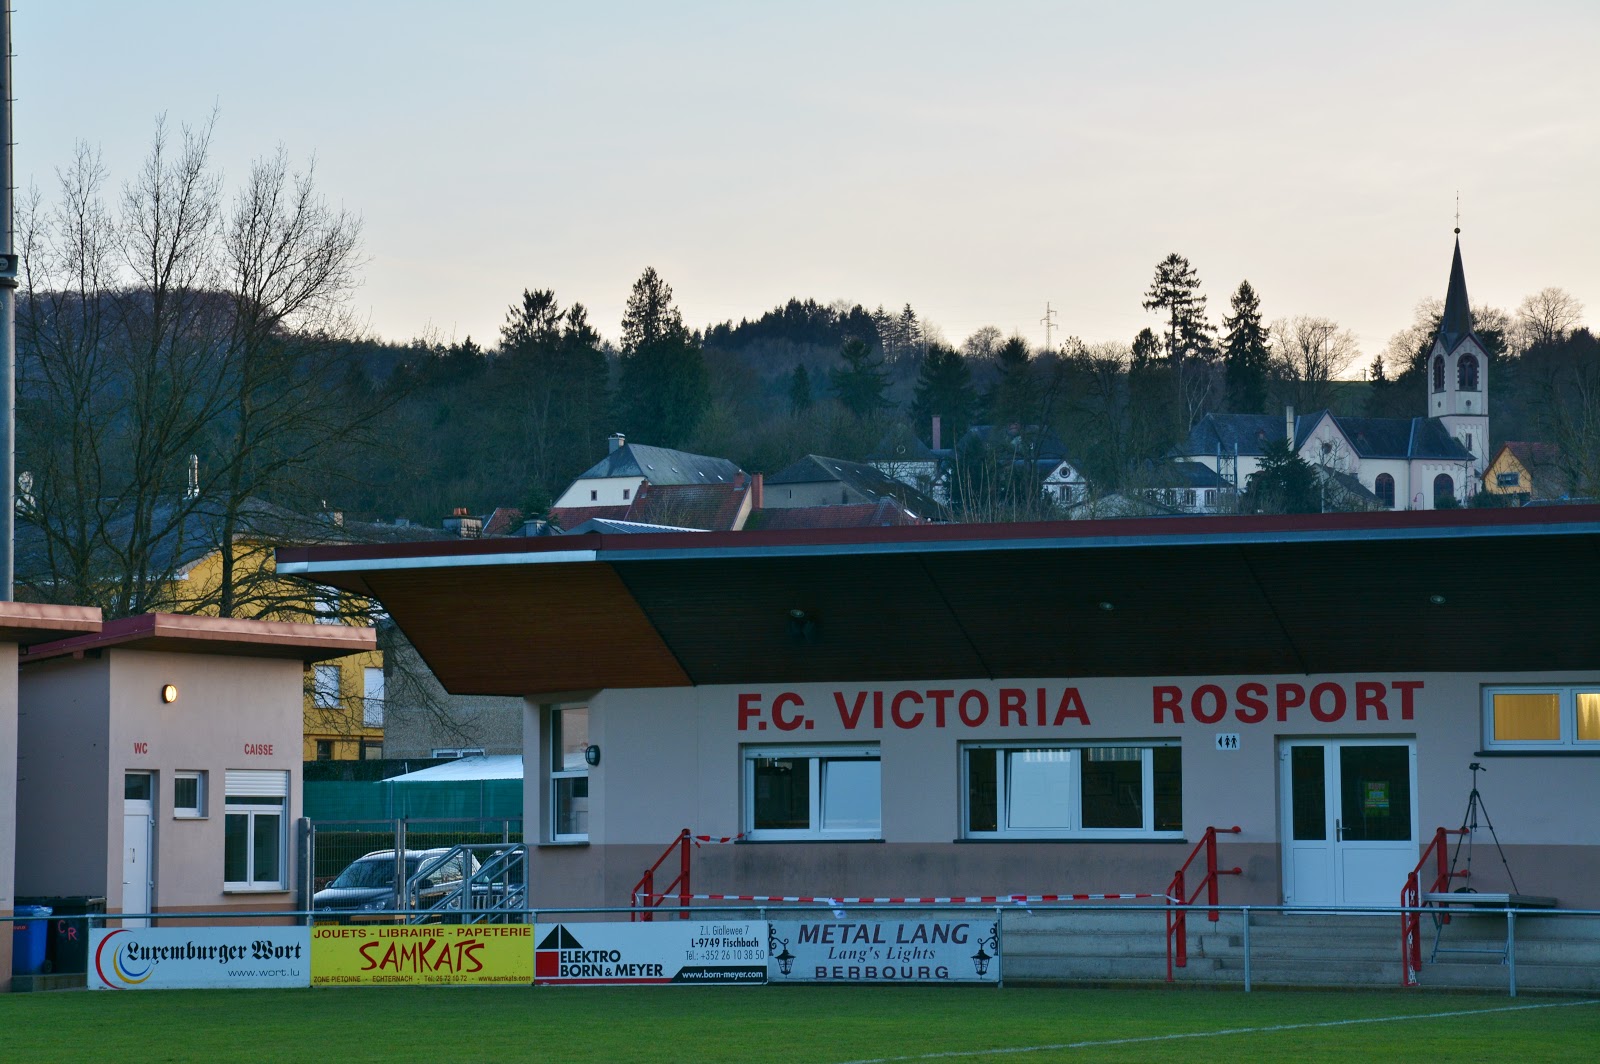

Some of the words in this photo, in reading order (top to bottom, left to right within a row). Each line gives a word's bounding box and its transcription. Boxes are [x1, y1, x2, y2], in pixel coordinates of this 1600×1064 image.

[738, 693, 814, 731] F.C.
[834, 687, 1091, 730] VICTORIA
[1153, 681, 1424, 723] ROSPORT
[134, 742, 148, 754] WC
[244, 744, 273, 755] CAISSE
[314, 929, 366, 938] JOUETS
[379, 928, 444, 938] LIBRAIRIE
[457, 928, 531, 936] PAPETERIE
[744, 925, 749, 934] 7
[798, 924, 886, 944] METAL
[896, 924, 969, 944] LANG
[691, 939, 720, 948] L-9749
[723, 938, 759, 947] Fischbach
[127, 941, 247, 965] Luxemburger
[252, 940, 301, 960] Wort
[359, 938, 485, 973] SAMKATS
[561, 950, 621, 963] ELEKTRO
[701, 950, 718, 960] +352
[721, 950, 730, 959] 26
[733, 950, 742, 959] 10
[744, 950, 753, 959] 38
[756, 950, 764, 959] 50
[828, 947, 880, 963] Lang's
[887, 946, 935, 963] Lights
[228, 969, 300, 977] www.wort.lu
[561, 964, 602, 977] BORN
[605, 968, 612, 976] &
[615, 964, 663, 976] MEYER
[682, 970, 763, 980] www.born-meyer.com
[816, 966, 949, 979] BERBOURG
